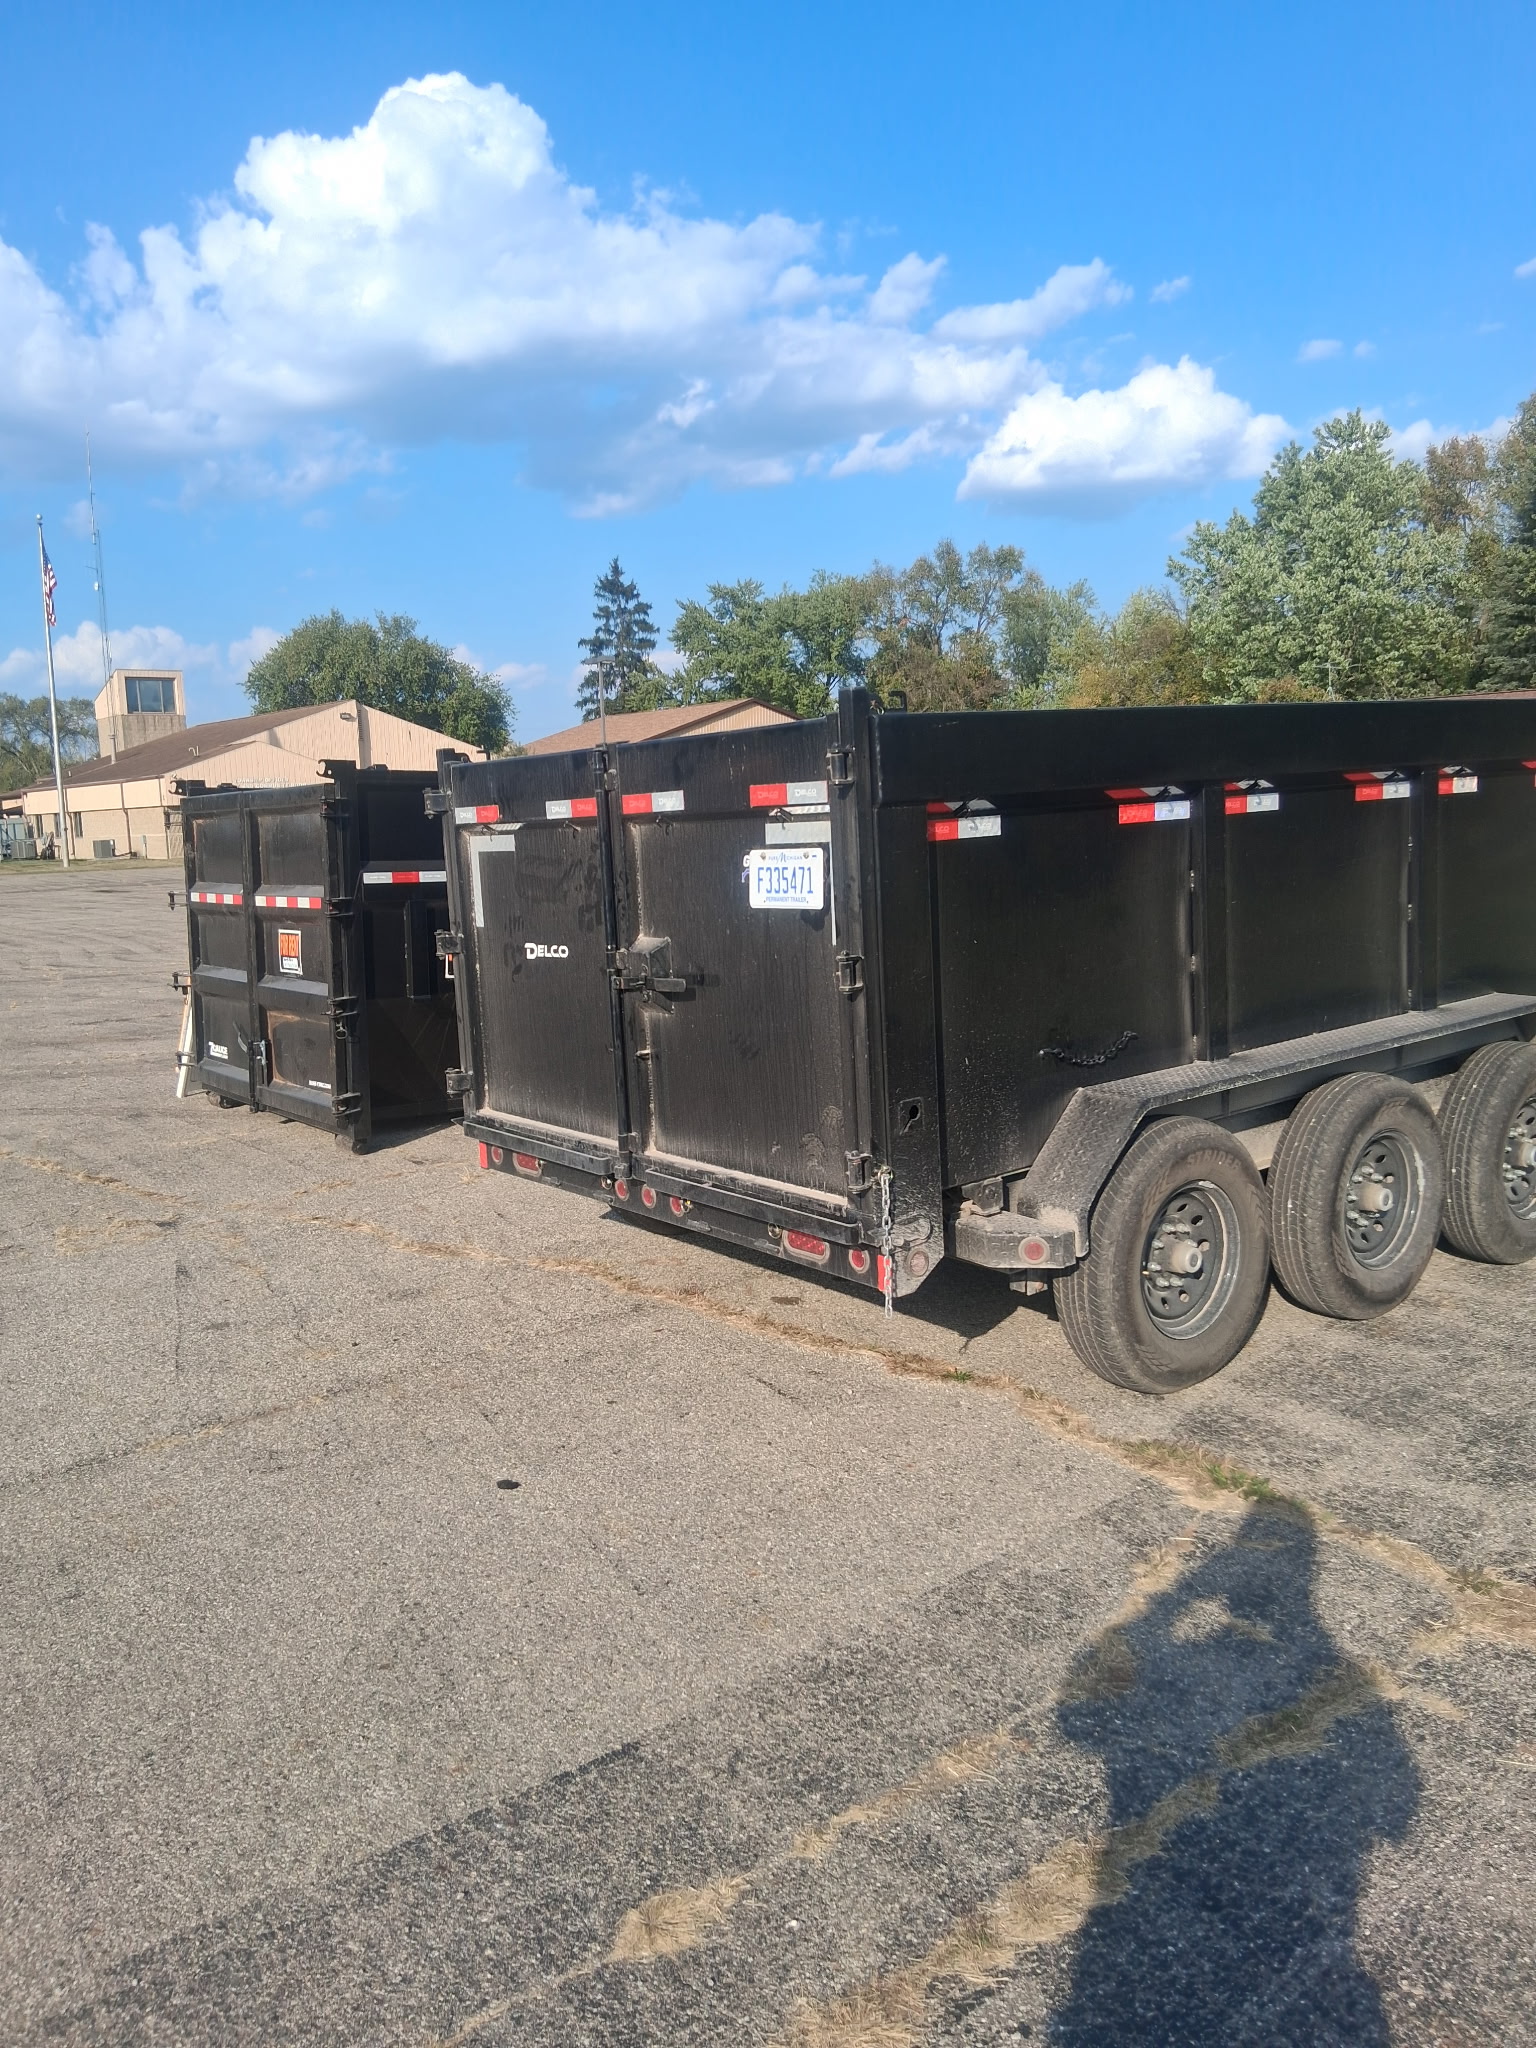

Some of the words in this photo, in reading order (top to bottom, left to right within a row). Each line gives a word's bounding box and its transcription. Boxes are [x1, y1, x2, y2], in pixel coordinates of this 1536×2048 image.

[757, 866, 814, 894] F335471
[524, 942, 569, 959] DELCO
[1186, 1149, 1242, 1169] STRIDER
